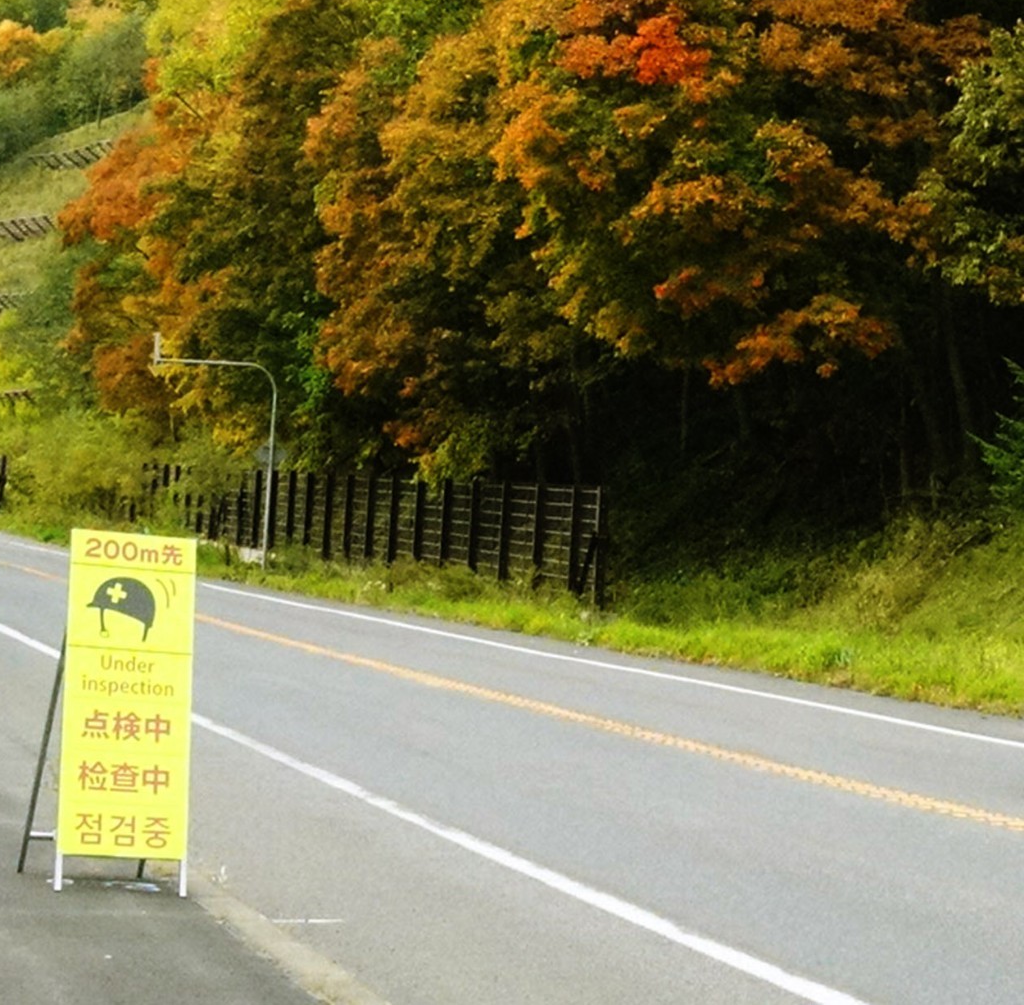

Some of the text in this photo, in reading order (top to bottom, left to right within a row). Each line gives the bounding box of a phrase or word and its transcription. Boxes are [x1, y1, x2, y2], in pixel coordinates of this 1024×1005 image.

[85, 537, 183, 566] 200m先
[100, 654, 155, 673] Under
[81, 674, 175, 697] inspection
[81, 709, 171, 744] 点検中
[78, 760, 170, 795] 检查中
[75, 813, 171, 849] 점검중
